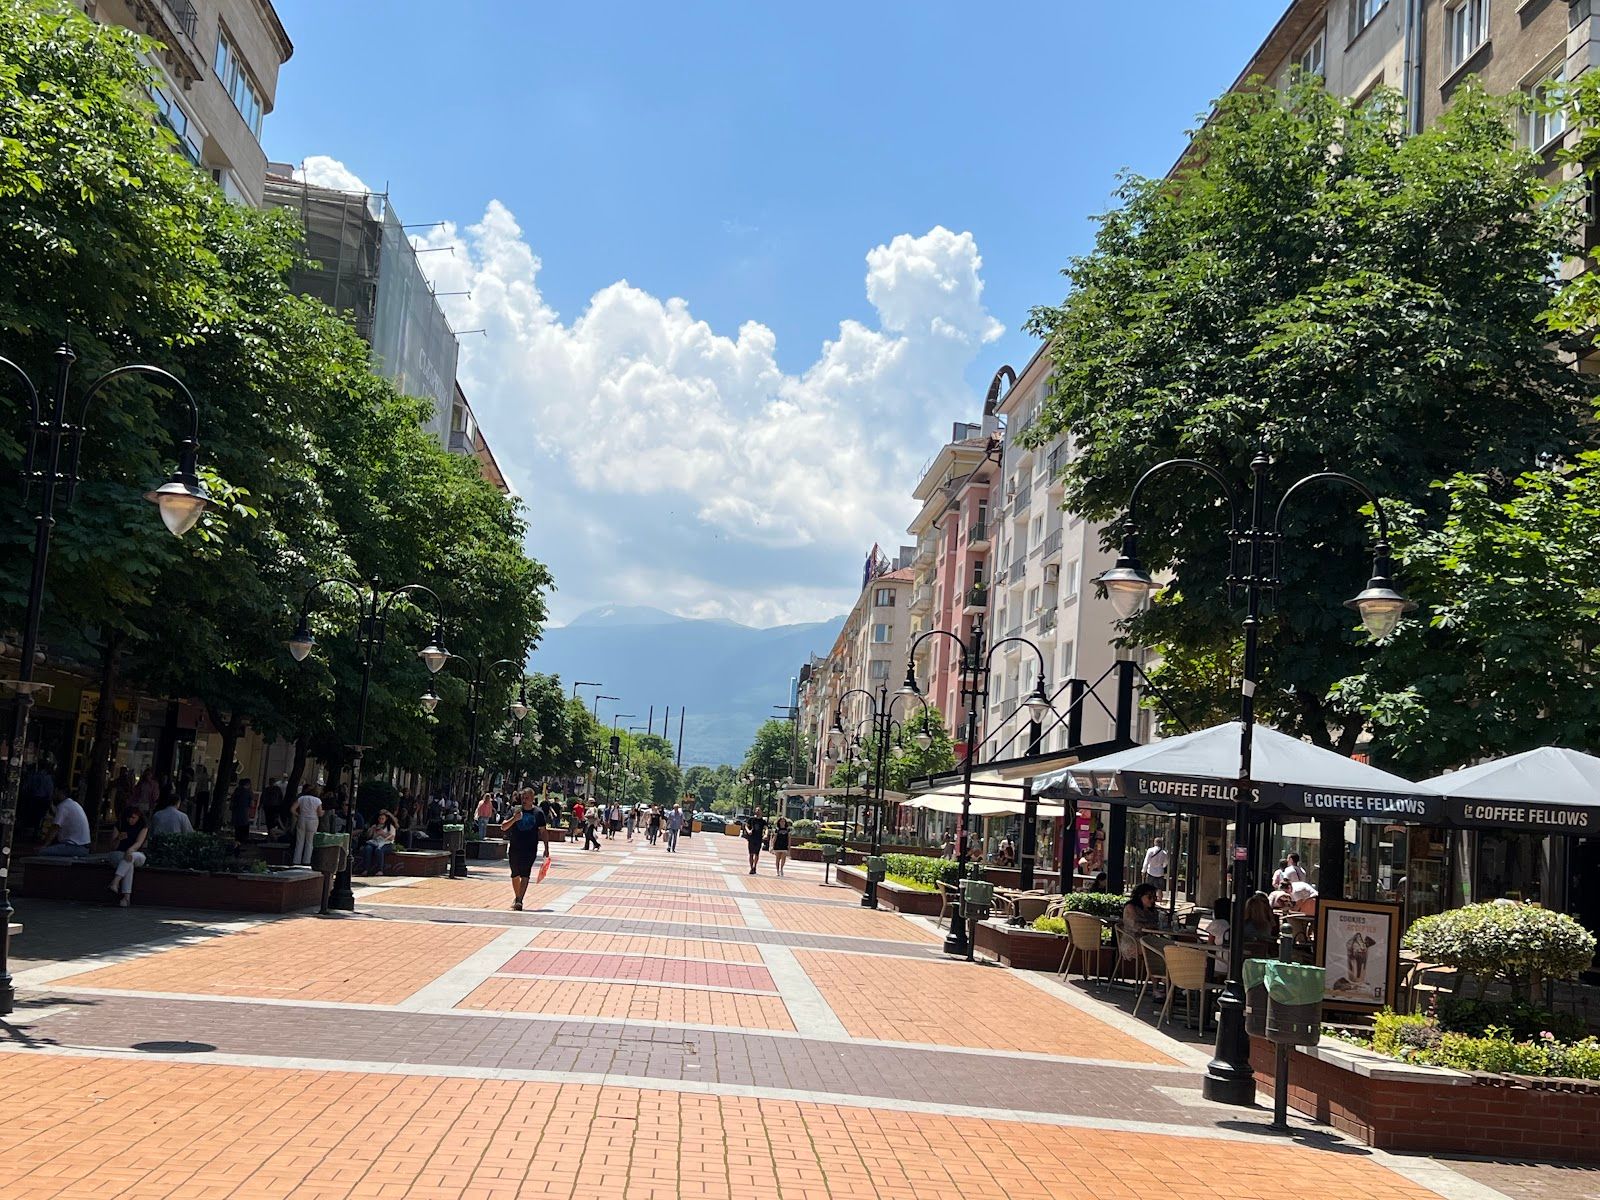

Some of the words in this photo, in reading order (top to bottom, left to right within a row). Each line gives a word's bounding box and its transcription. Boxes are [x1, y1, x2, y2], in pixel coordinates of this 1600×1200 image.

[1149, 780, 1198, 797] COFFEE
[1200, 784, 1260, 803] FELLOS
[1315, 793, 1364, 810] COFFEE
[1366, 797, 1426, 815] FELLOWS
[1475, 806, 1525, 822] COFFEE
[1528, 809, 1589, 827] FELLOWS
